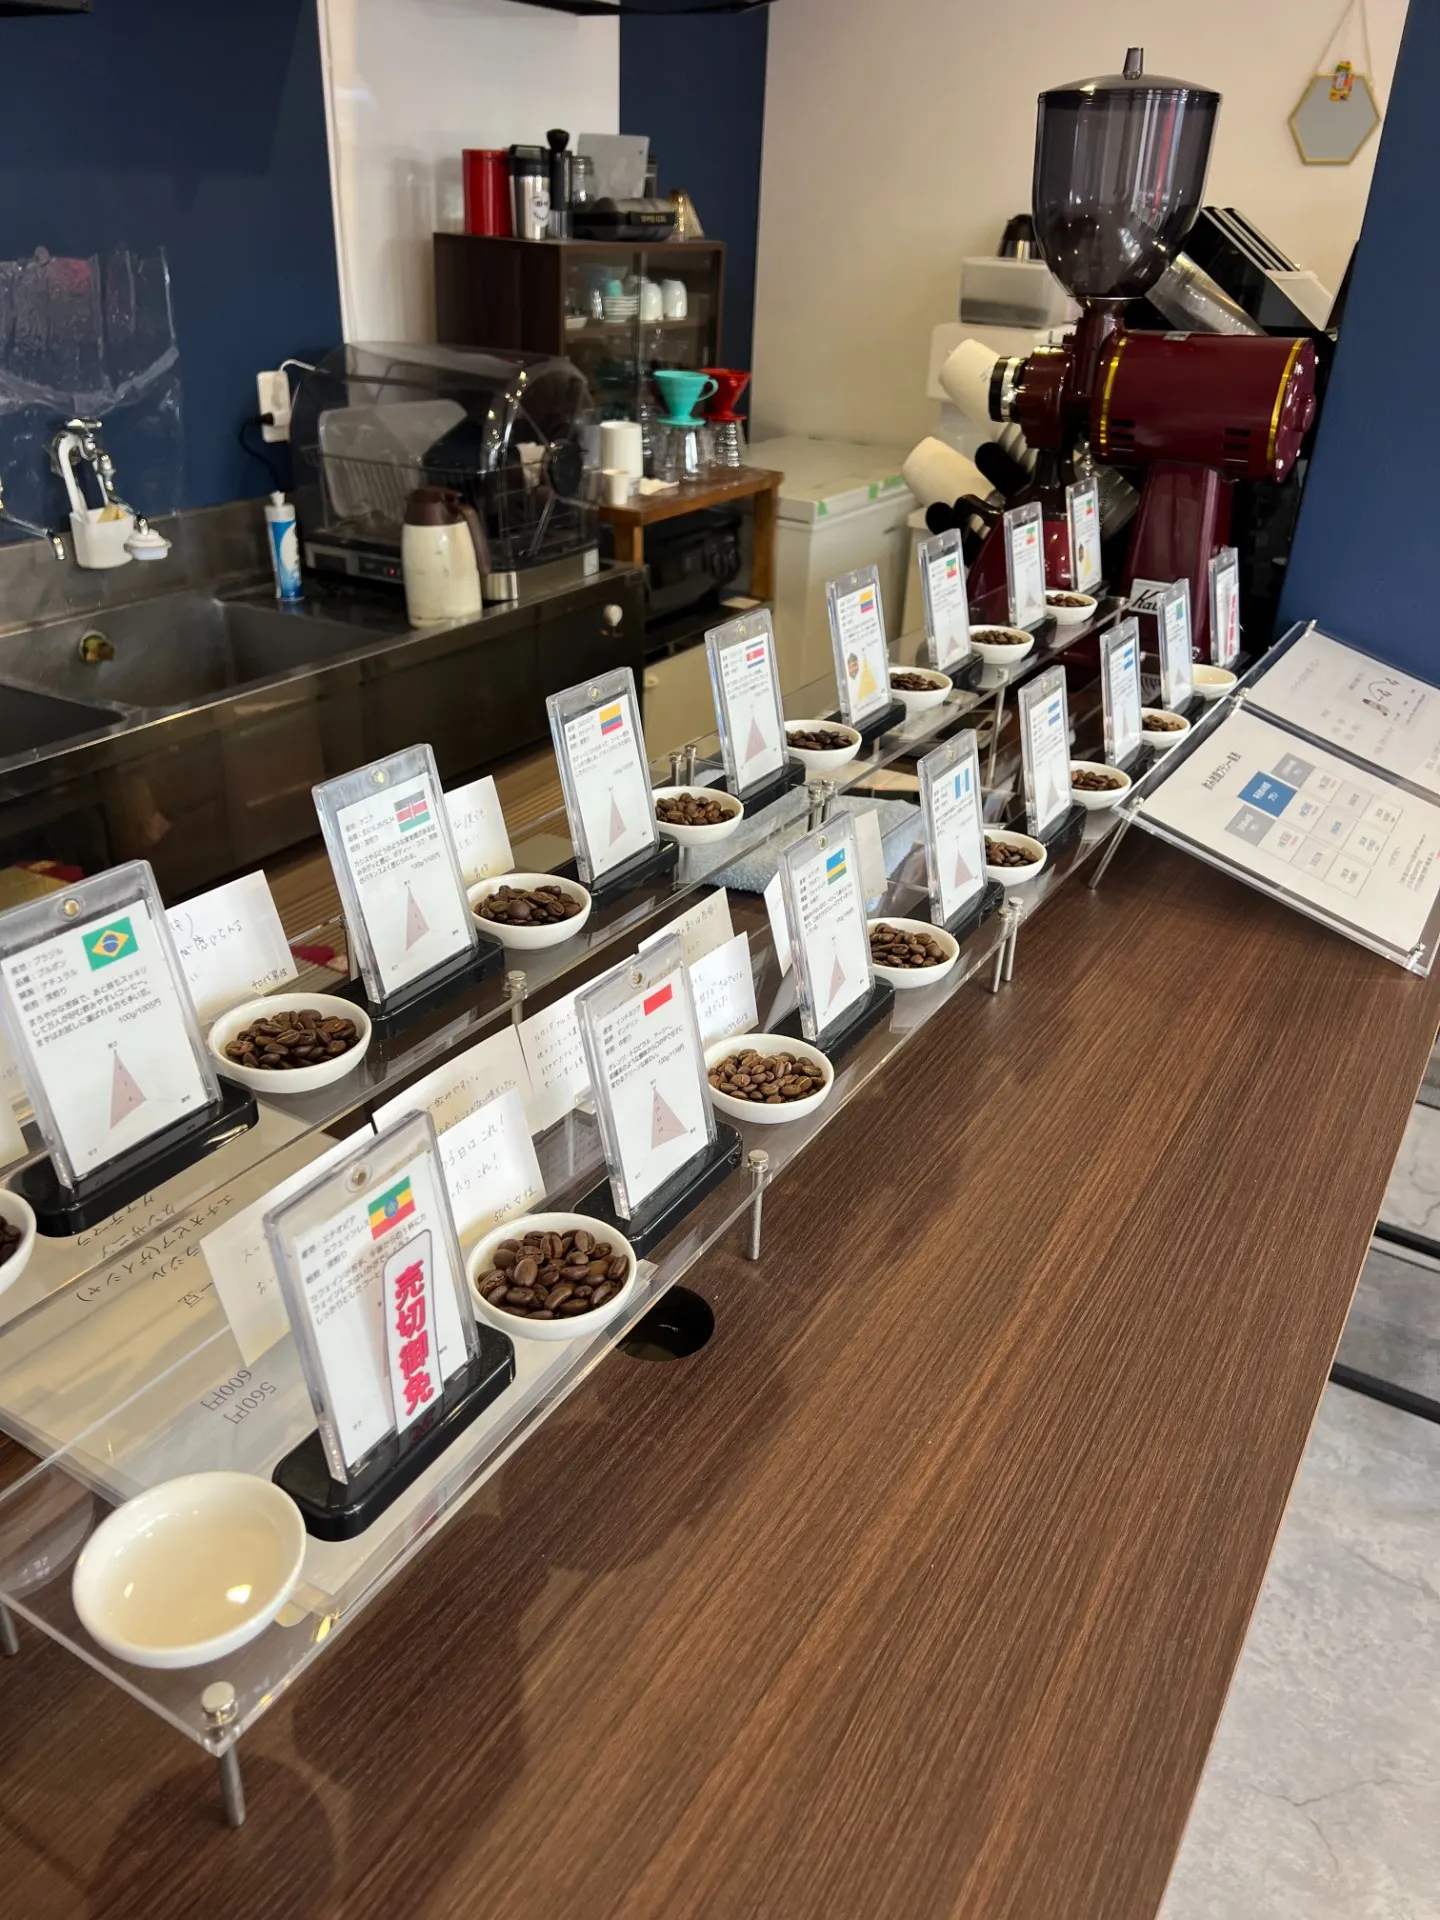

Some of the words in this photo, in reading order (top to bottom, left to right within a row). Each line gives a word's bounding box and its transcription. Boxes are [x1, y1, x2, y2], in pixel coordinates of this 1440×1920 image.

[151, 1247, 200, 1281] ラジル
[395, 1259, 434, 1416] 売切御免
[199, 1369, 252, 1411] 600円
[223, 1381, 277, 1424] 560円
